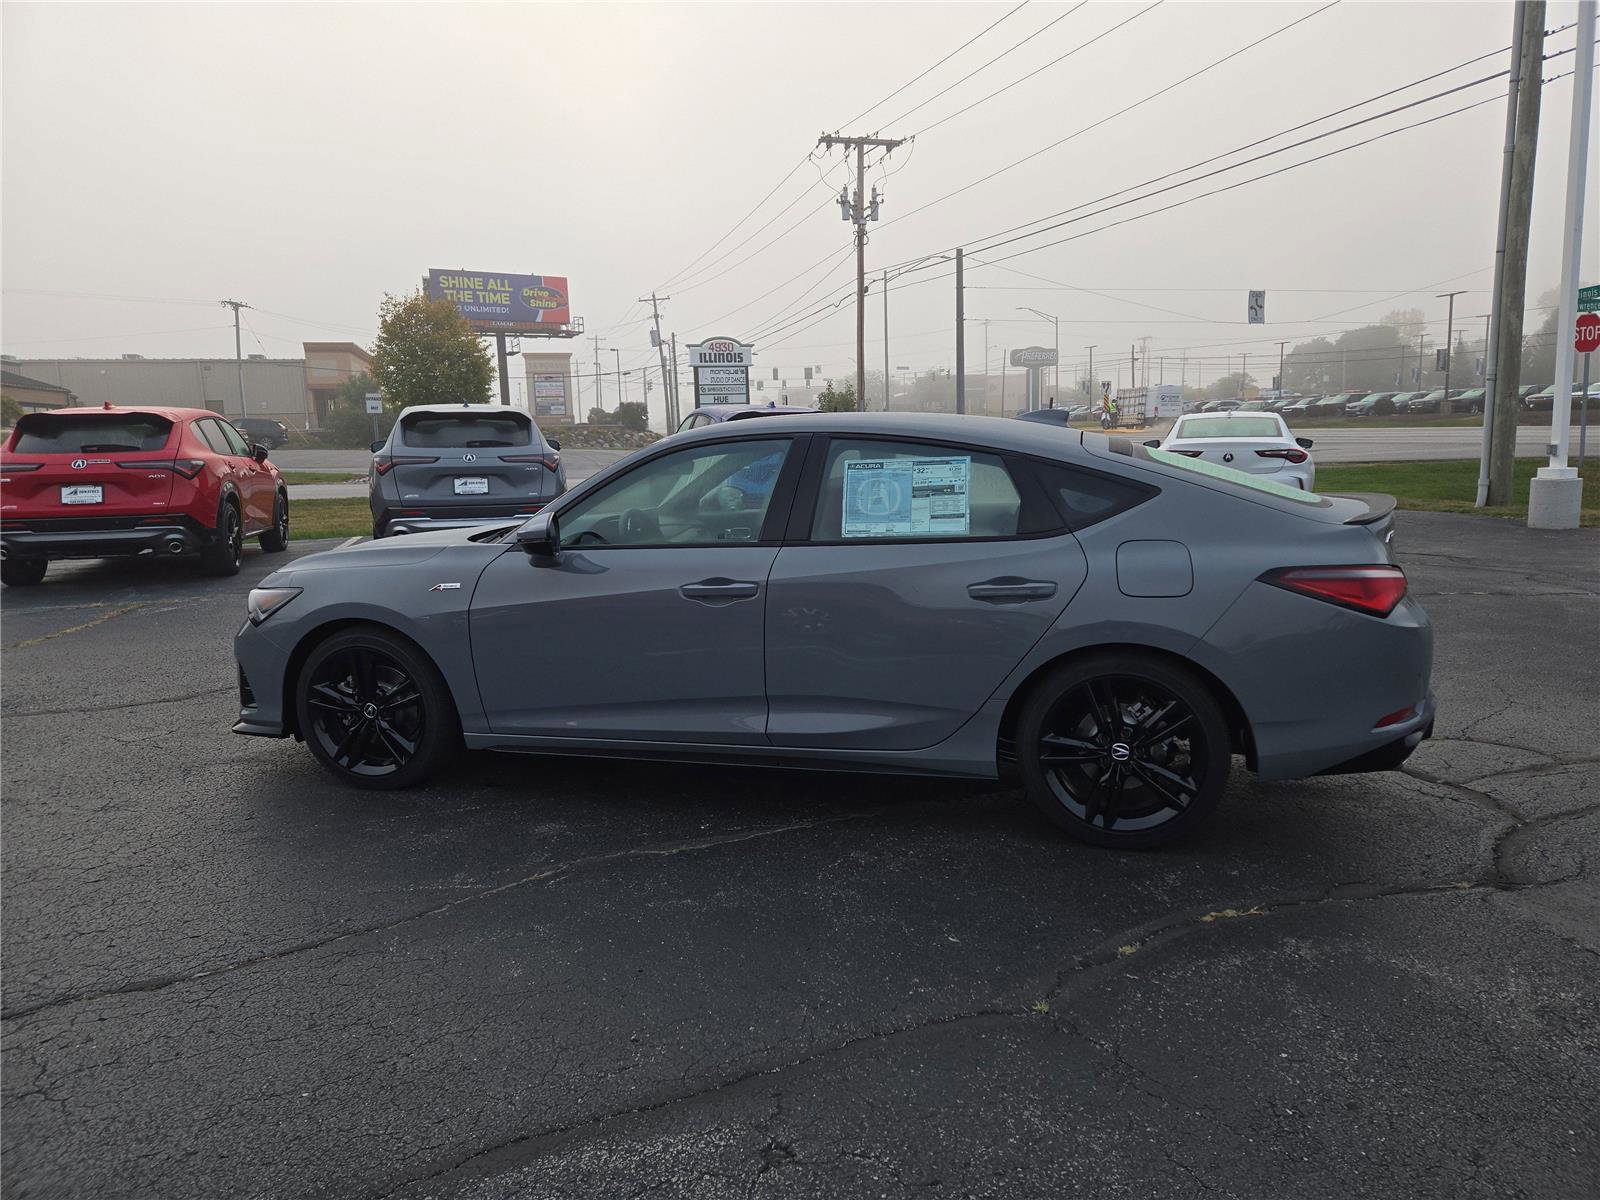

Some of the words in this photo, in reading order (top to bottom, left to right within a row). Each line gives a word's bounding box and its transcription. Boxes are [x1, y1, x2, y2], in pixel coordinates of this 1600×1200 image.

[439, 275, 484, 290] SHINE
[487, 278, 513, 291] ALL
[443, 290, 474, 303] THE
[476, 291, 511, 305] TIME
[523, 288, 549, 297] Drive
[1580, 288, 1598, 298] inois
[530, 299, 557, 308] Shine
[708, 342, 734, 353] 4930
